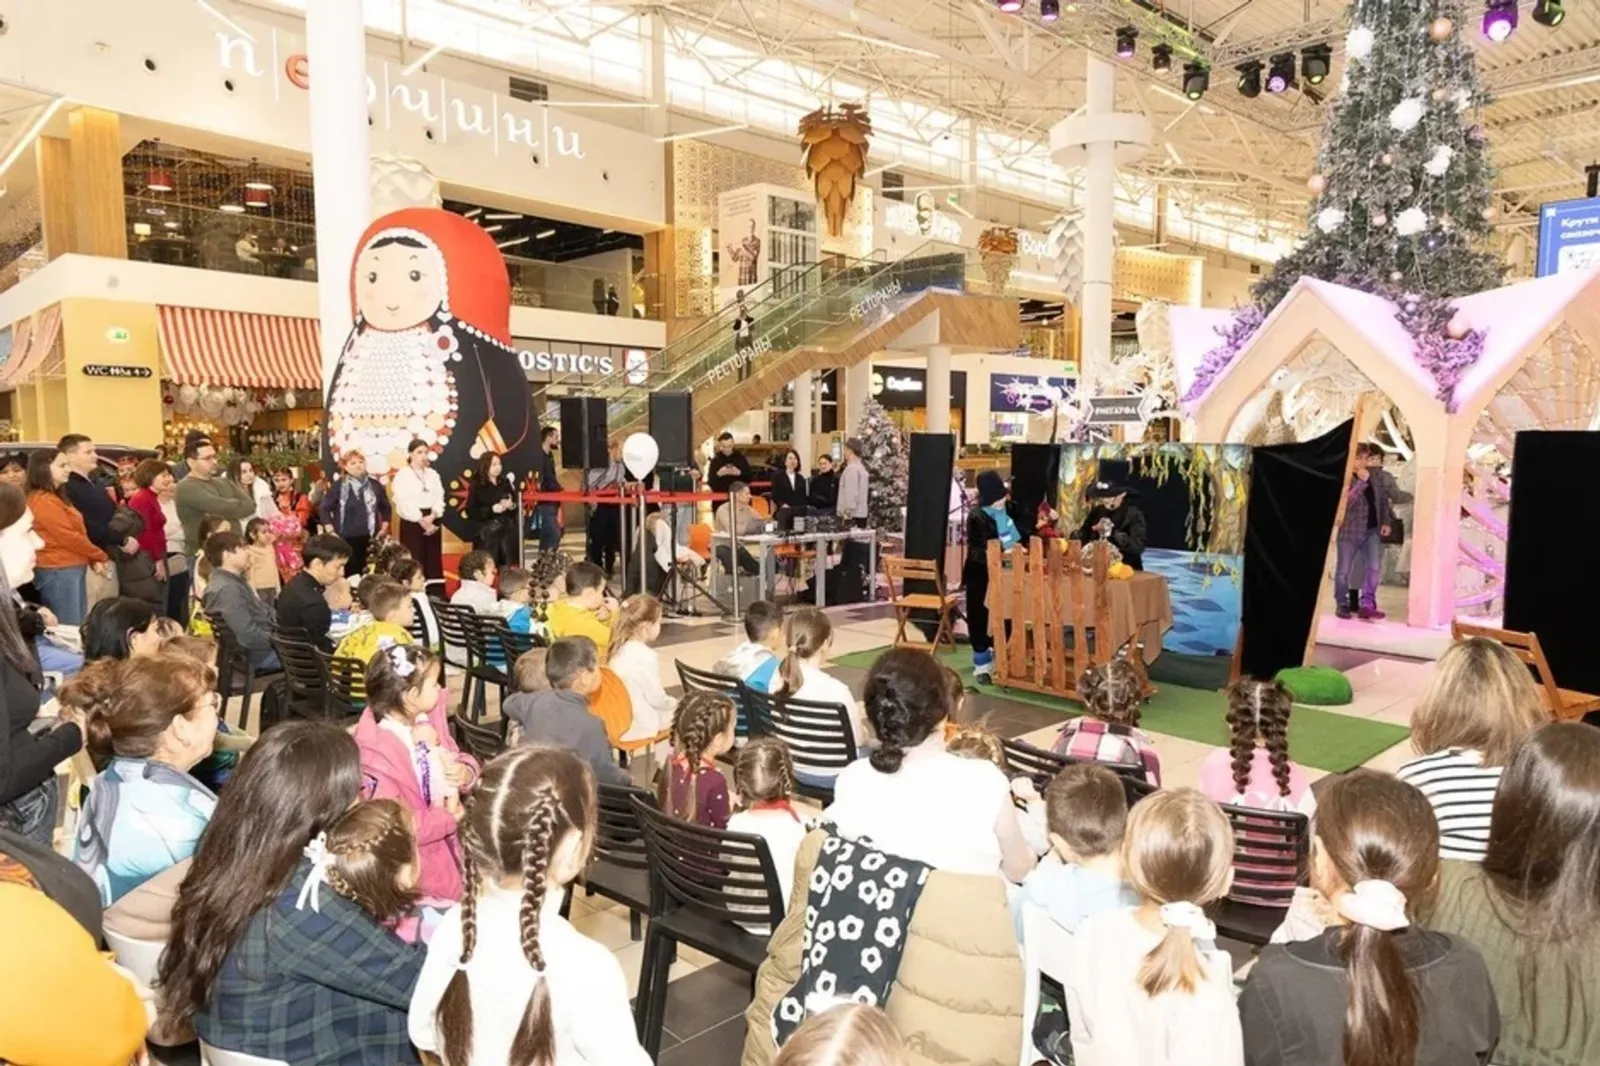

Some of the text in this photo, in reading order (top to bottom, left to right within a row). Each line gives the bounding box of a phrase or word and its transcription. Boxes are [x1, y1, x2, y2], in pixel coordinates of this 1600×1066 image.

[850, 279, 901, 321] РЕСТОРАНЫ
[517, 350, 614, 375] OSTIC'S
[708, 335, 772, 385] РЕСТОРАНЫ
